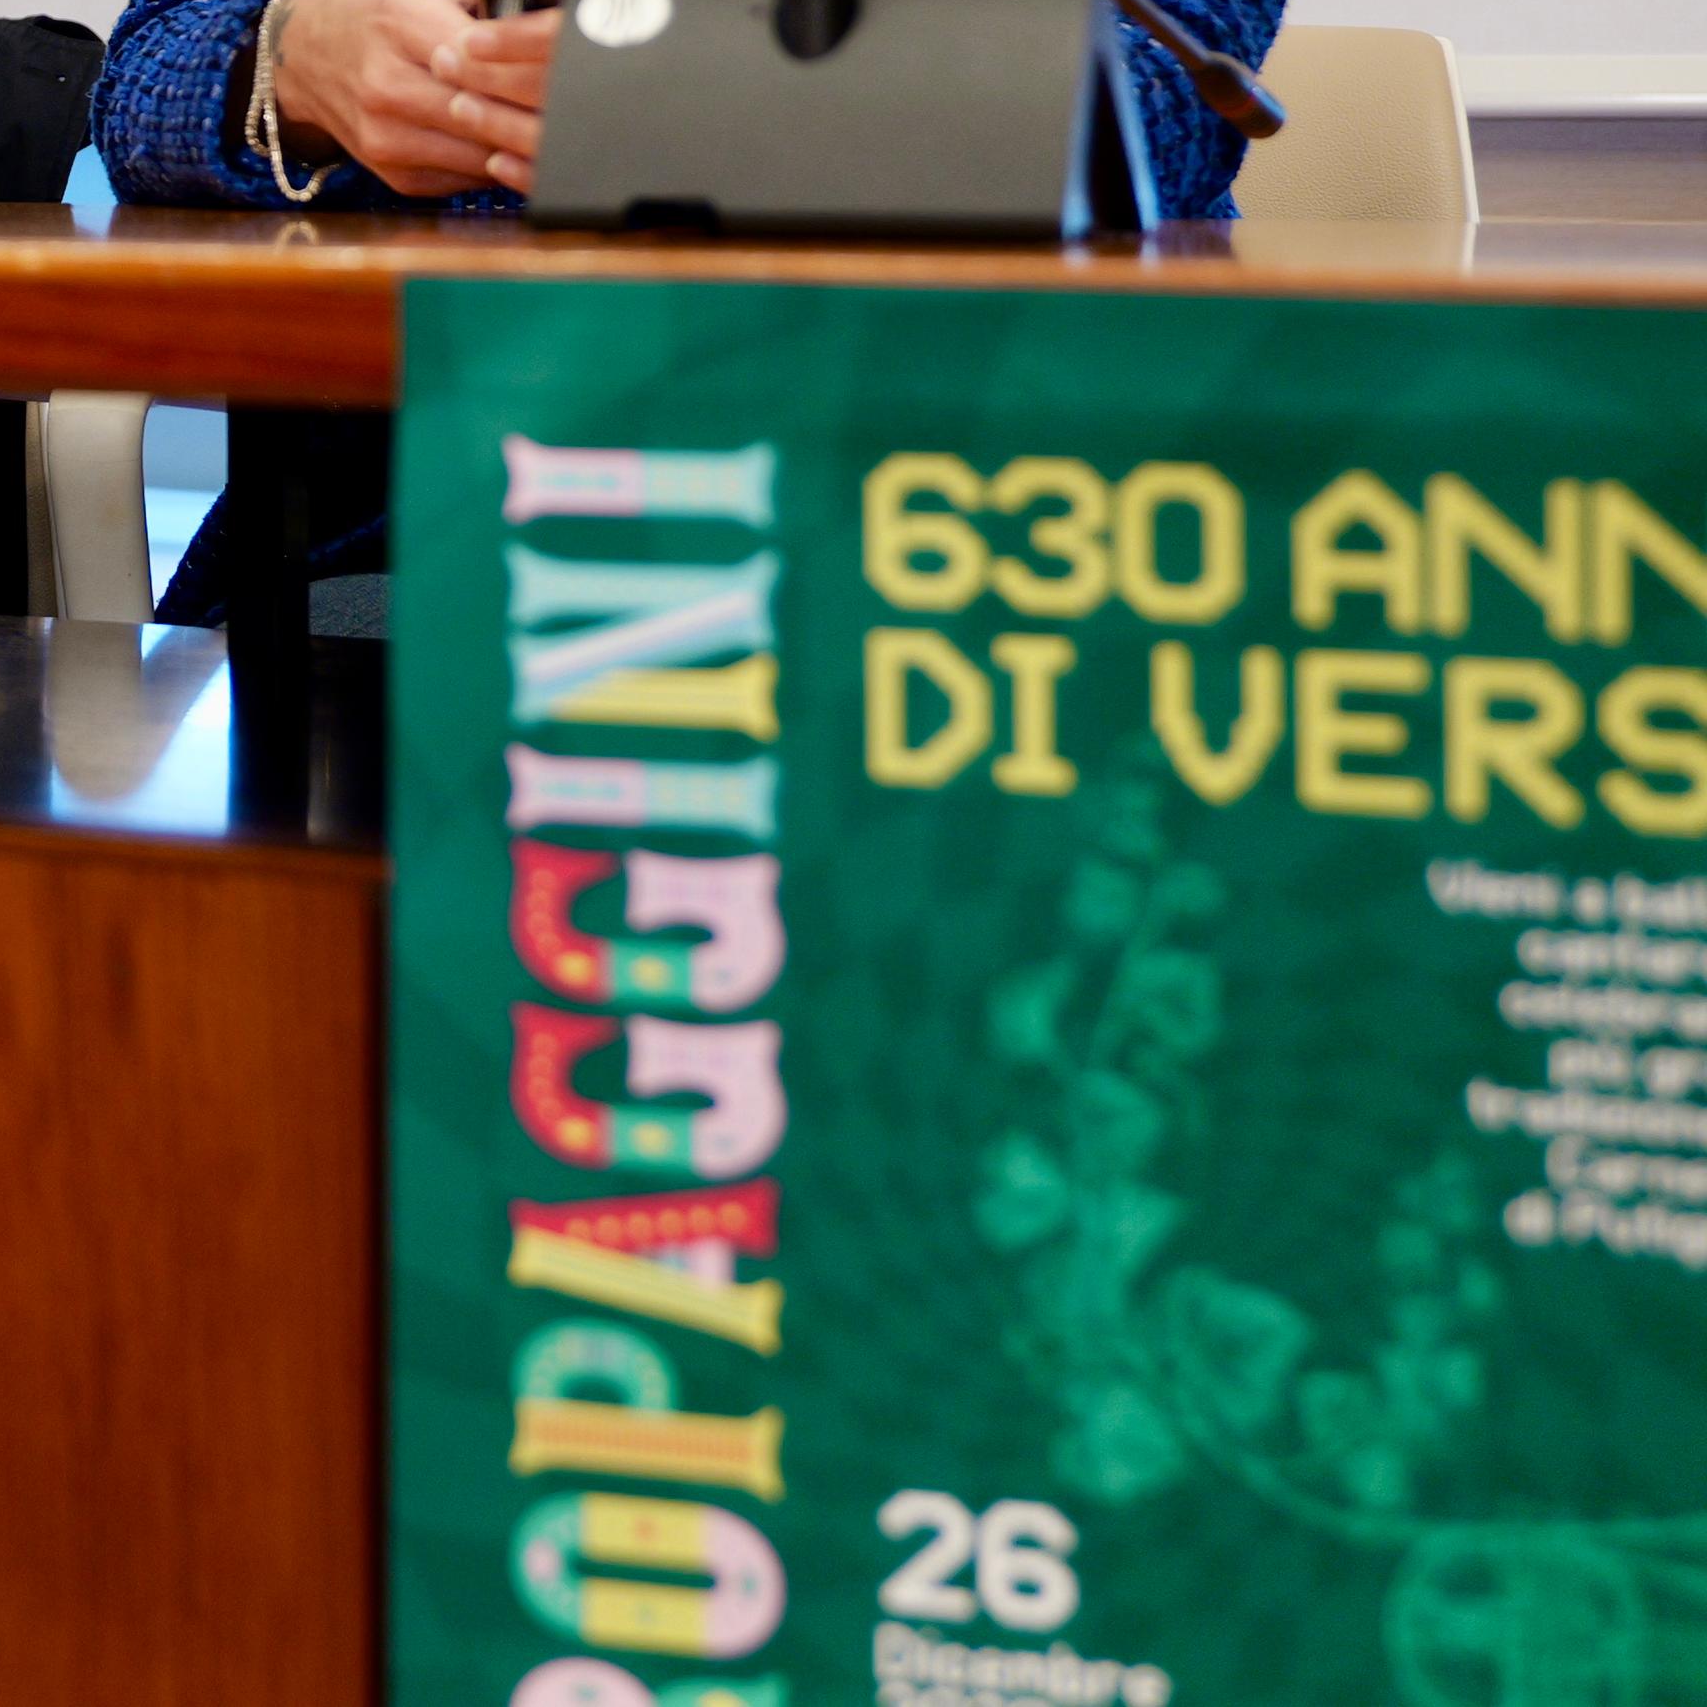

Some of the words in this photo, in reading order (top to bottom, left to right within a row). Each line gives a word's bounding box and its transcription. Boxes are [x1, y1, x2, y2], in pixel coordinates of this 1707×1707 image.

[862, 450, 1248, 626] 630
[1289, 466, 1707, 648] ANN
[862, 623, 1080, 798] DI
[1148, 639, 1707, 840] VERS
[1425, 856, 1564, 921] Vieni
[875, 1487, 1081, 1635] 26
[871, 1619, 1173, 1707] Dicembre
